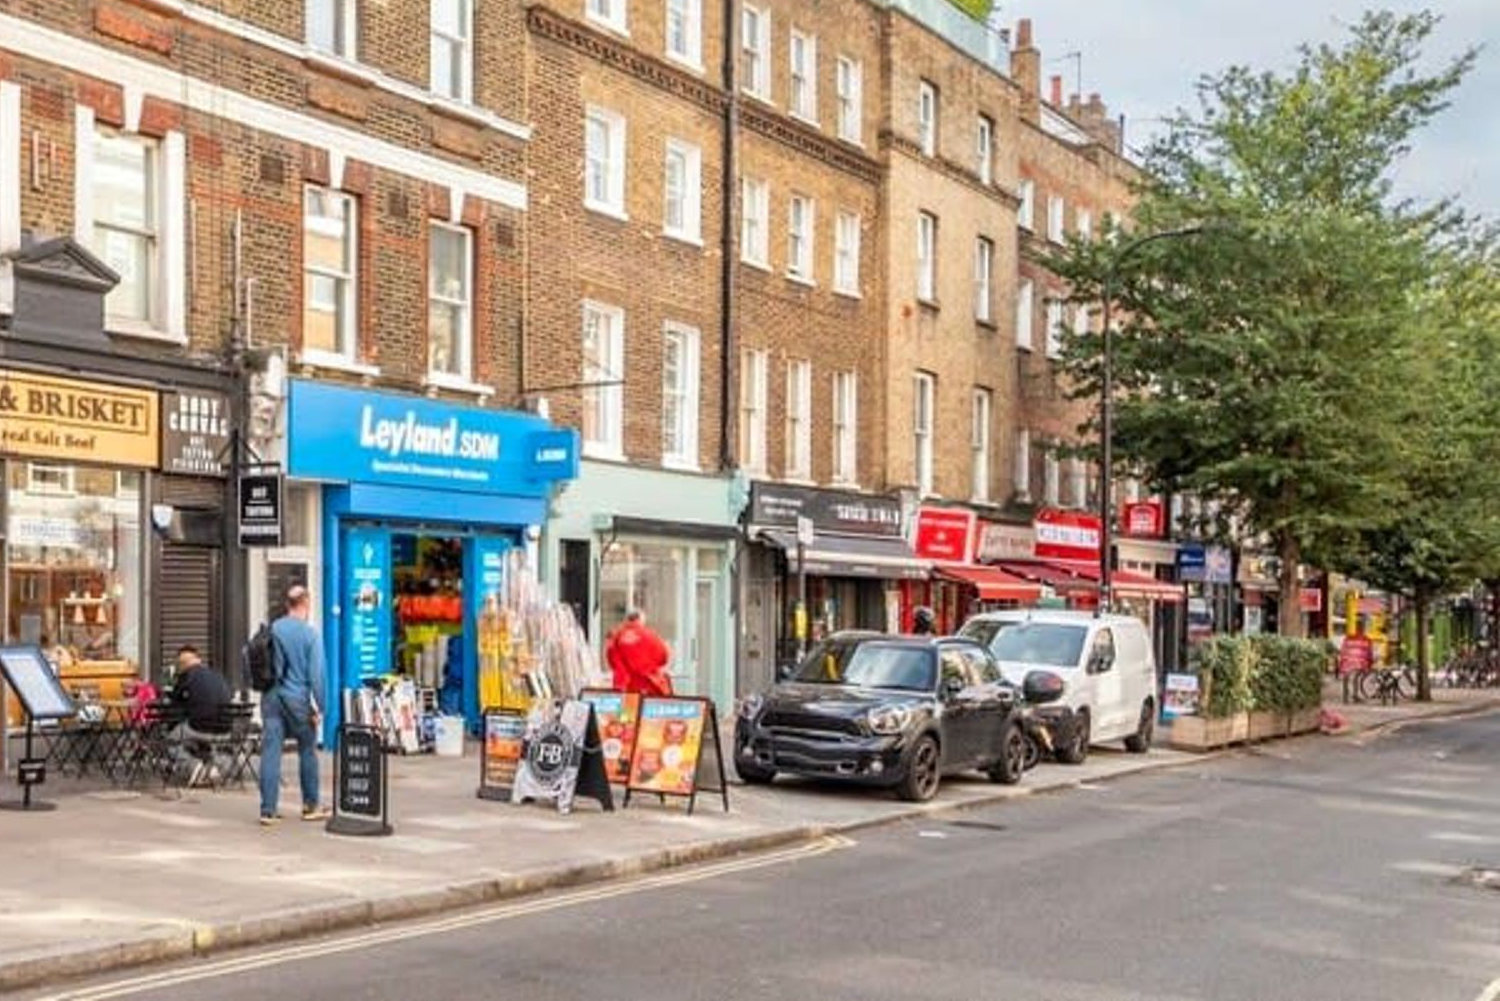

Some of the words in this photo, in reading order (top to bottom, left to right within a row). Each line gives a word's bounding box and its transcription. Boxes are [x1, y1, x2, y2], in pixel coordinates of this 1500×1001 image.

[28, 390, 144, 427] BRISKET
[2, 428, 30, 442] real
[34, 430, 61, 446] Salt
[65, 434, 97, 450] Beef
[360, 405, 457, 456] Leyland
